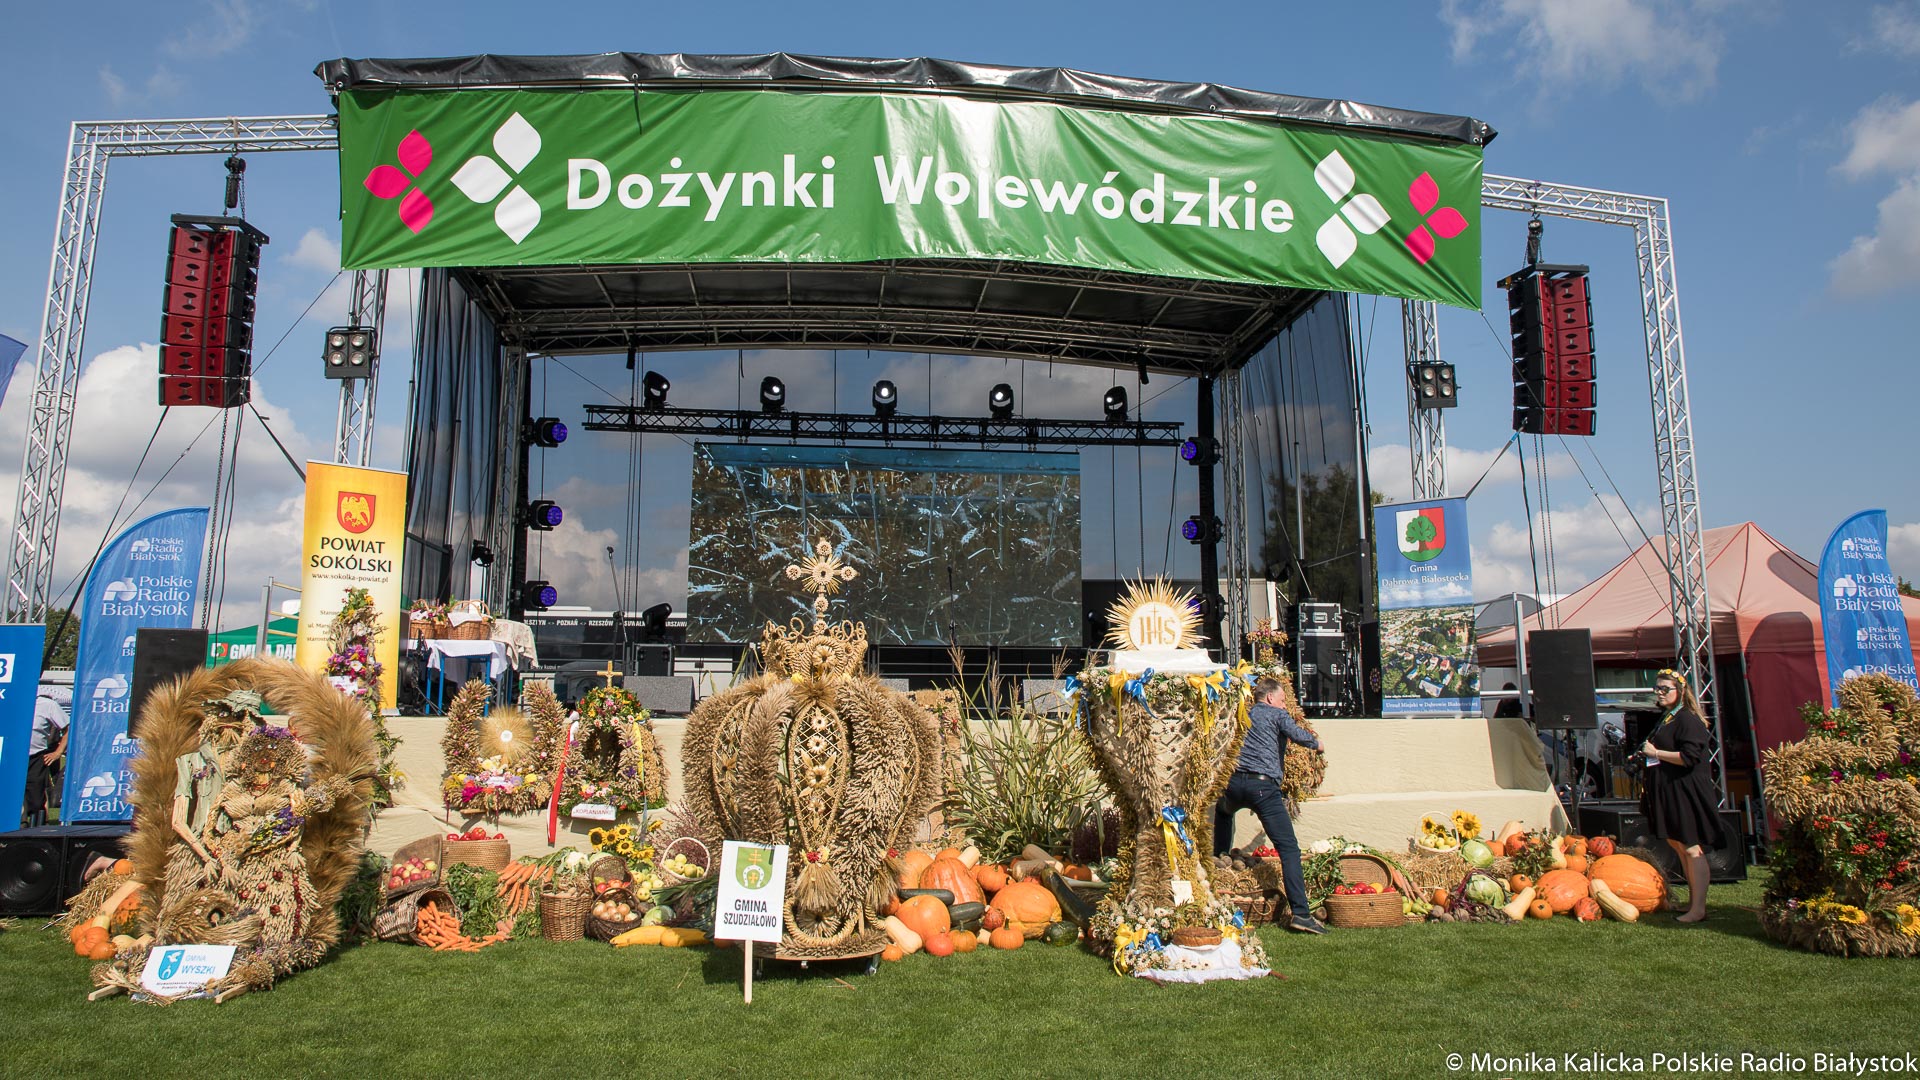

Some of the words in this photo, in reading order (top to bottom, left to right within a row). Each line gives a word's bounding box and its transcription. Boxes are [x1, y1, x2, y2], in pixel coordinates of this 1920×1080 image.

[566, 154, 836, 222] Dożynki
[873, 155, 1295, 234] Wojewódzkie
[150, 537, 184, 546] Polskie
[320, 536, 386, 554] POWIAT
[150, 545, 183, 553] Radio
[1855, 544, 1882, 552] Radio
[130, 552, 181, 562] Białystok
[310, 554, 392, 573] SOKÓLSKI
[1409, 564, 1438, 573] Gmina
[140, 576, 193, 588] Polskie
[312, 573, 389, 583] www.sokolka-powiat.pl
[1382, 577, 1419, 588] Dąbrowa
[1421, 572, 1469, 584] Białostocka
[138, 587, 190, 602] Radio
[1858, 585, 1899, 598] Radio
[102, 602, 188, 619] Białystok
[588, 618, 614, 627] RZESZÓW
[1139, 616, 1176, 646] IHS
[1869, 633, 1901, 641] Radio
[734, 899, 768, 912] GMINA
[724, 912, 777, 928] SZUDZIAŁOWO
[182, 965, 216, 974] WYSZKI
